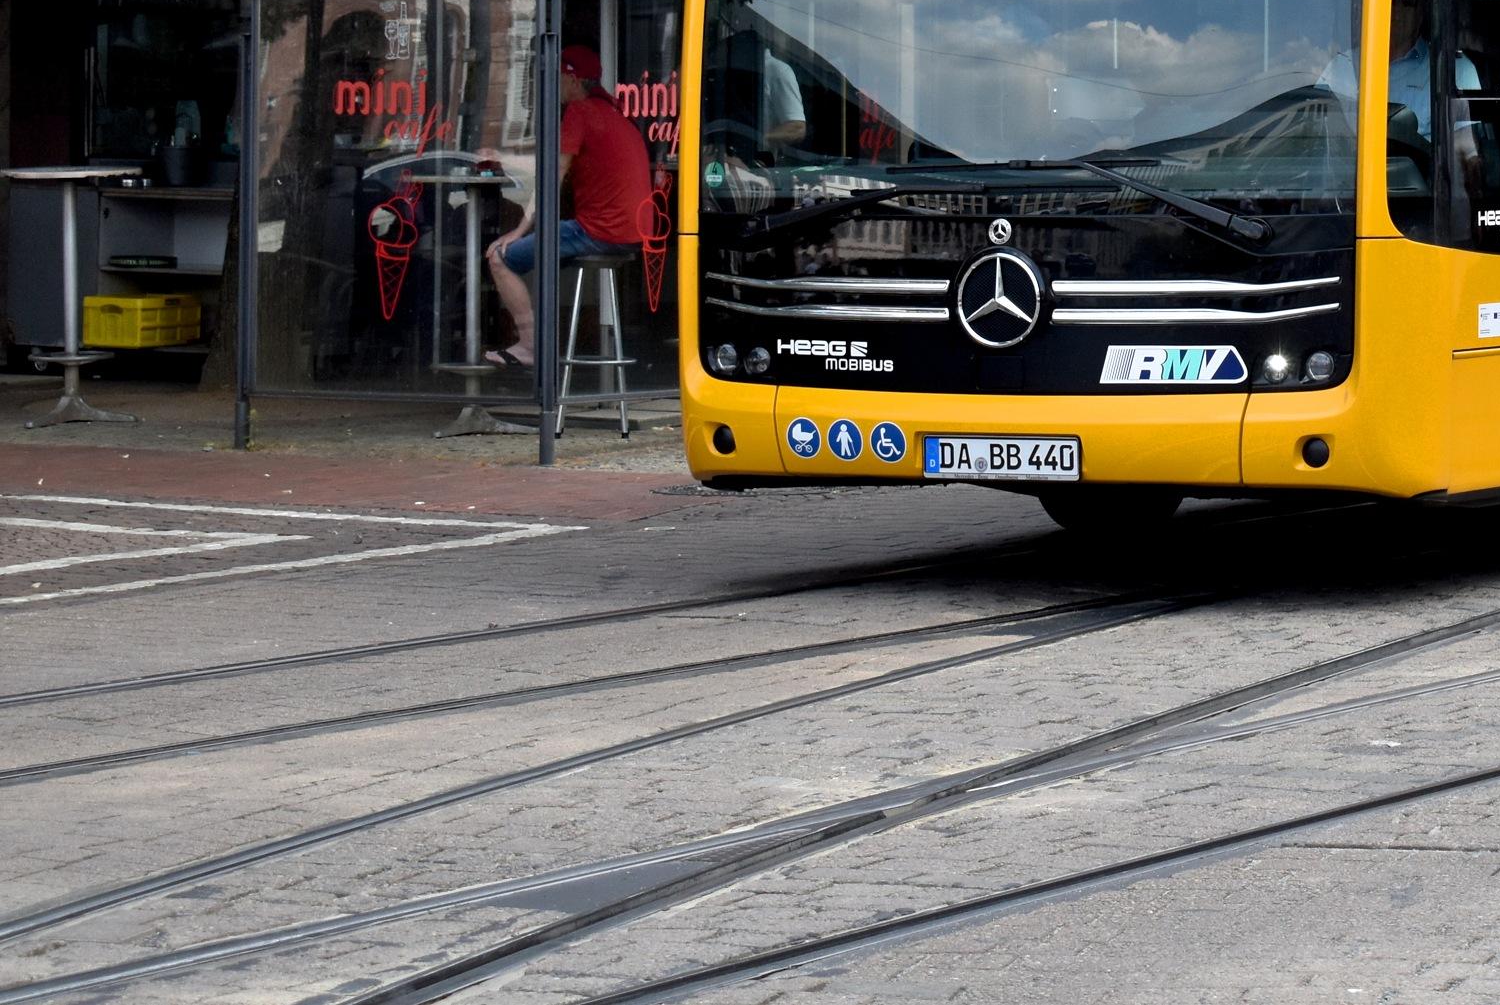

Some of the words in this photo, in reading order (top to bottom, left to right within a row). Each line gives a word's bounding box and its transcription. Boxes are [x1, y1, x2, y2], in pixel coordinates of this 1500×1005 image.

[334, 68, 428, 116] mini
[616, 70, 677, 117] mini
[711, 161, 718, 175] 4
[1127, 348, 1232, 381] RMV
[929, 459, 936, 468] D
[940, 442, 972, 470] DA
[989, 443, 1022, 471] BB
[1028, 444, 1075, 471] 440
